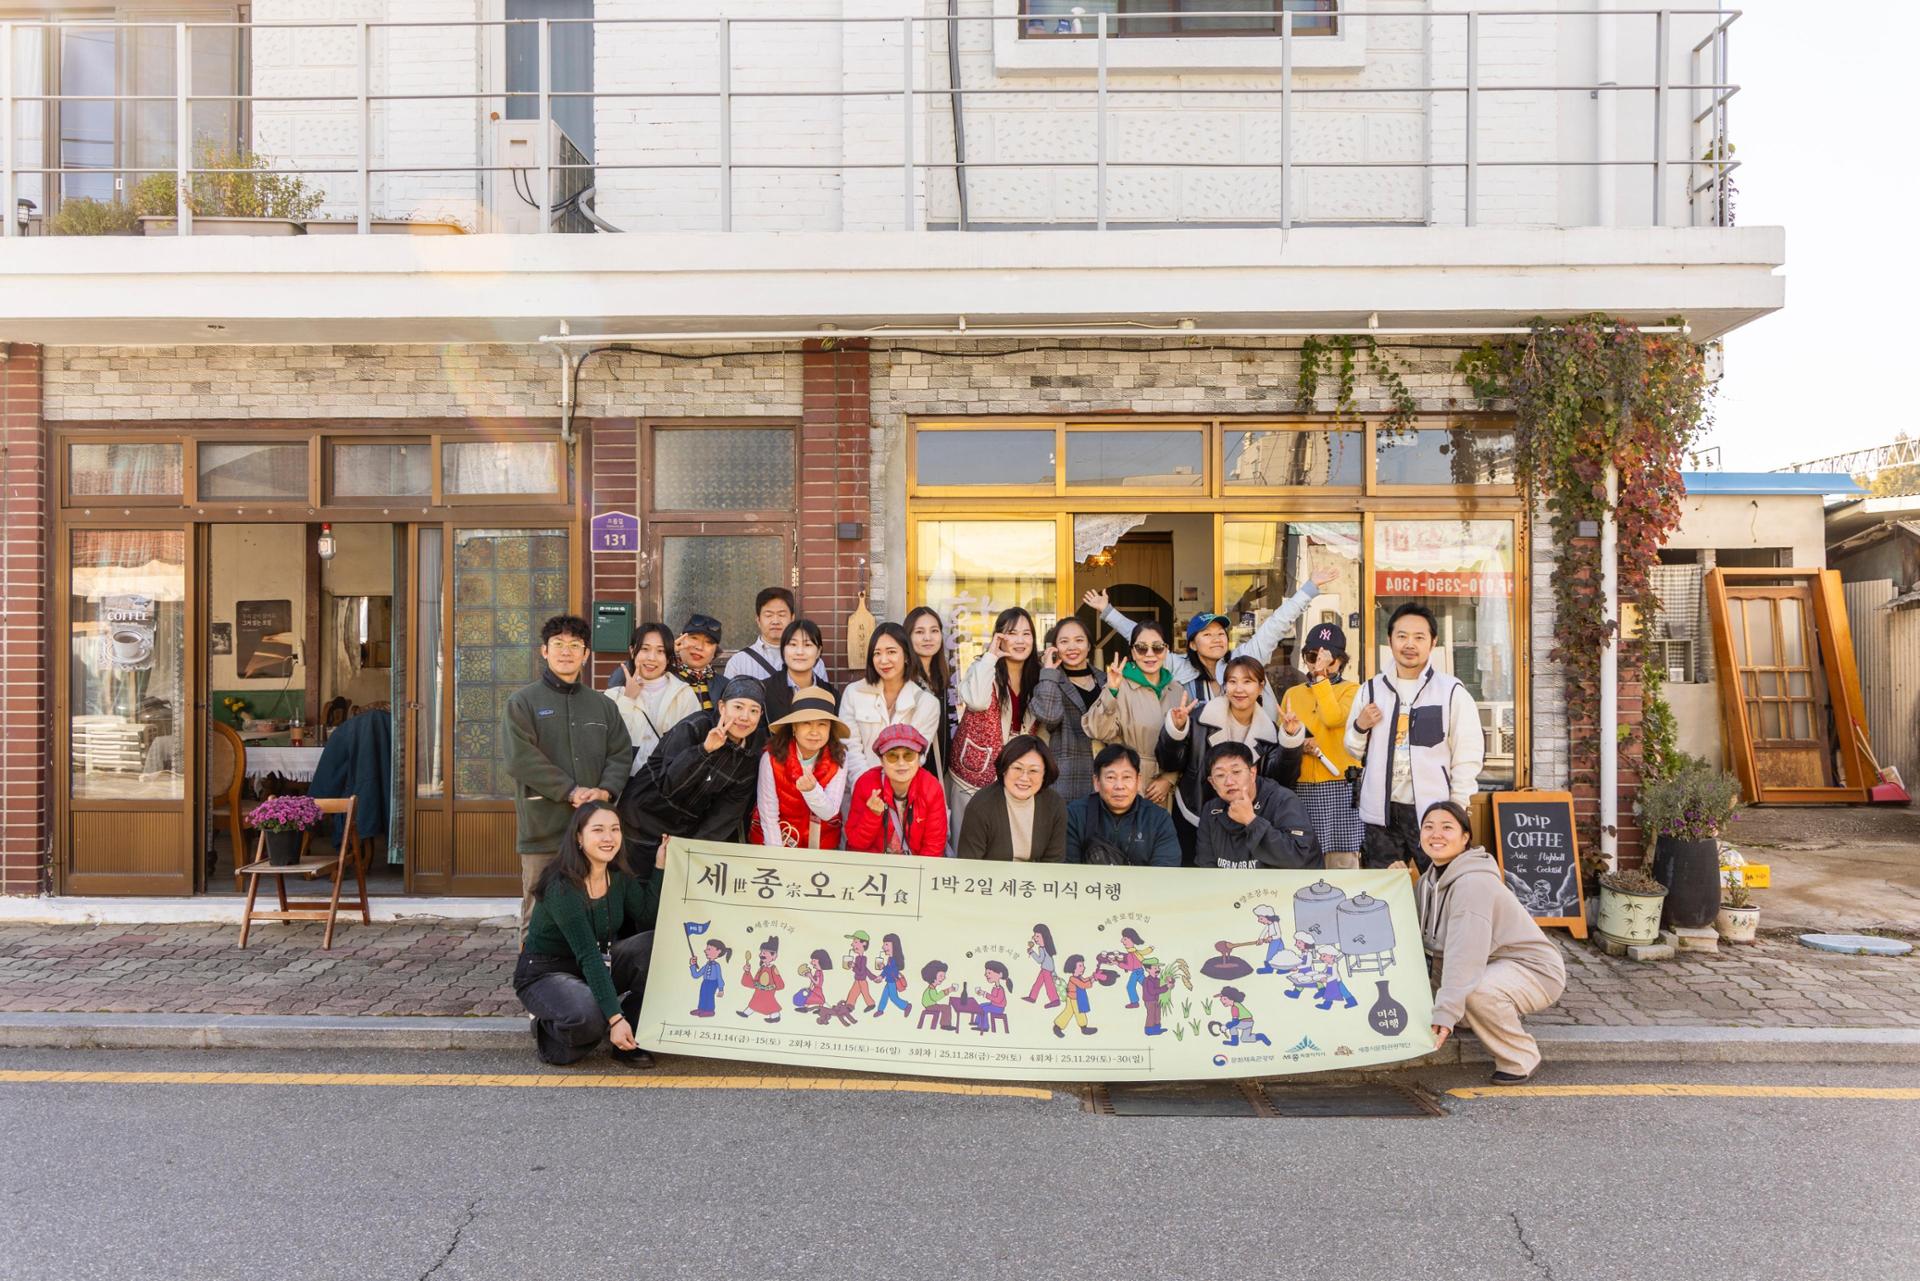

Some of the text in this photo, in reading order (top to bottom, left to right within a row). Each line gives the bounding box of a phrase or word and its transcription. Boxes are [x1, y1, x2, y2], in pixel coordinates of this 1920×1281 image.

[604, 533, 627, 547] 131
[1514, 812, 1551, 829] Drip
[1507, 831, 1564, 849] COFFEE
[1217, 857, 1238, 869] URBN
[931, 876, 1121, 902] 1박 2일 세종 미식 여행
[1377, 1008, 1397, 1019] 미식
[1378, 1018, 1399, 1029] 여행
